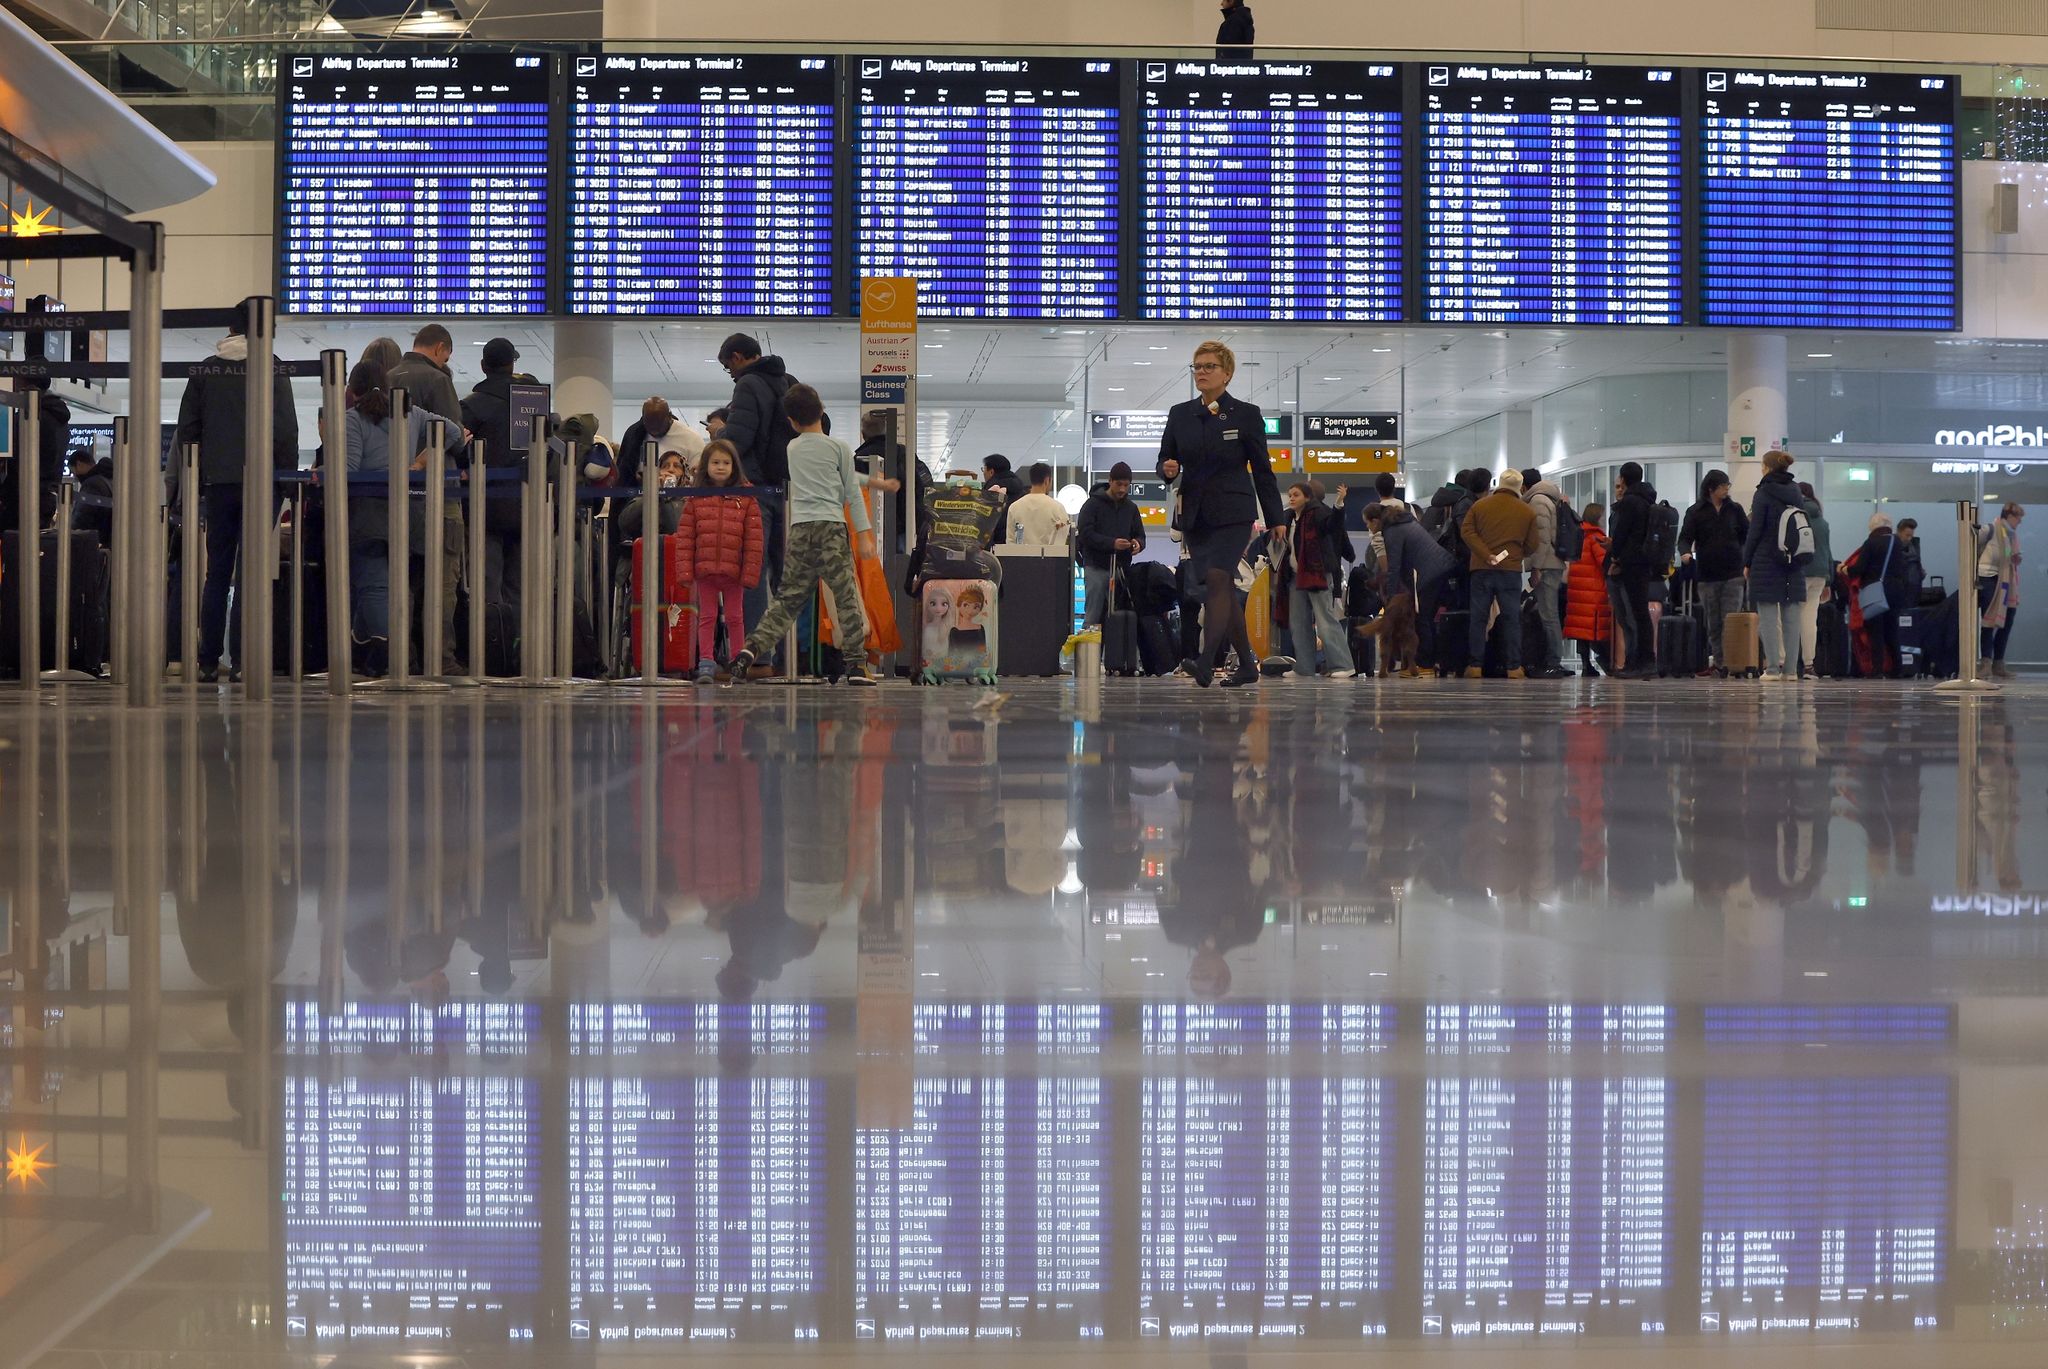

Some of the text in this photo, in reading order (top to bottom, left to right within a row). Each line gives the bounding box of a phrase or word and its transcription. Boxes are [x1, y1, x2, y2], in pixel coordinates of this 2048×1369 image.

[322, 57, 458, 70] Abflug Departures Terminal 2
[606, 58, 742, 70] Abflug Departures Terminal 2
[891, 60, 1028, 72] Abflug Departures Terminal 2
[1175, 63, 1311, 76] Abflug Departures Terminal 2
[1457, 67, 1592, 80] Abflug Departures Terminal 2
[1735, 73, 1866, 87] Abflug Departures Terminal 2
[293, 104, 331, 112] Aufgrund
[335, 104, 349, 112] der
[354, 104, 397, 112] gestrigen
[402, 104, 473, 112] Wettersituation
[596, 104, 610, 113] 327
[619, 104, 657, 113] Singapur
[702, 105, 724, 113] 12:05
[777, 106, 815, 114] Check-in
[862, 106, 872, 114] LH
[882, 106, 895, 114] 111
[905, 107, 947, 115] Frankfurt
[987, 108, 1010, 116] 15:00
[1043, 108, 1058, 117] K23
[1062, 109, 1105, 117] Lufthansa
[1147, 110, 1156, 118] LH
[1167, 110, 1180, 118] 115
[1190, 110, 1231, 119] Frankfurt
[1271, 111, 1294, 120] 17:00
[1327, 112, 1341, 120] K16
[1346, 112, 1384, 121] Check-in
[335, 117, 354, 125] noch
[293, 129, 344, 137] Flugverkehr
[1448, 126, 1463, 134] 926
[1472, 126, 1505, 135] Vilnius
[1551, 128, 1574, 136] 20:55
[1625, 129, 1667, 138] Lufthansa
[292, 141, 306, 150] Wir
[311, 141, 339, 150] bitten
[576, 166, 585, 174] TP
[618, 167, 657, 175] Lissabon
[701, 167, 723, 176] 12:50
[729, 167, 752, 176] 14:55
[776, 168, 814, 176] Check-in
[905, 169, 932, 177] Taipei
[987, 170, 1009, 178] 15:30
[1726, 168, 1741, 176] 742
[1749, 168, 1773, 177] Osaka
[1899, 173, 1941, 181] Lufthansa
[292, 179, 301, 187] TP
[310, 179, 325, 187] 557
[334, 179, 372, 187] Lissabon
[415, 179, 438, 187] 06:05
[490, 179, 528, 187] Check-in
[1167, 222, 1180, 230] 116
[1189, 222, 1209, 230] Wien
[1271, 223, 1294, 231] 19:15
[1346, 224, 1384, 232] Check-in
[310, 228, 324, 237] 352
[333, 229, 371, 237] Warschau
[414, 229, 438, 237] 09:45
[471, 229, 485, 237] K10
[3, 317, 75, 328] ALLIANCE
[865, 319, 912, 329] Lufthansa
[866, 337, 899, 345] Austrian
[188, 366, 220, 376] STAR
[865, 381, 906, 389] Business
[865, 390, 890, 398] Class
[1324, 417, 1370, 426] Sperrgepäck
[1324, 427, 1378, 437] Bulky Baggage
